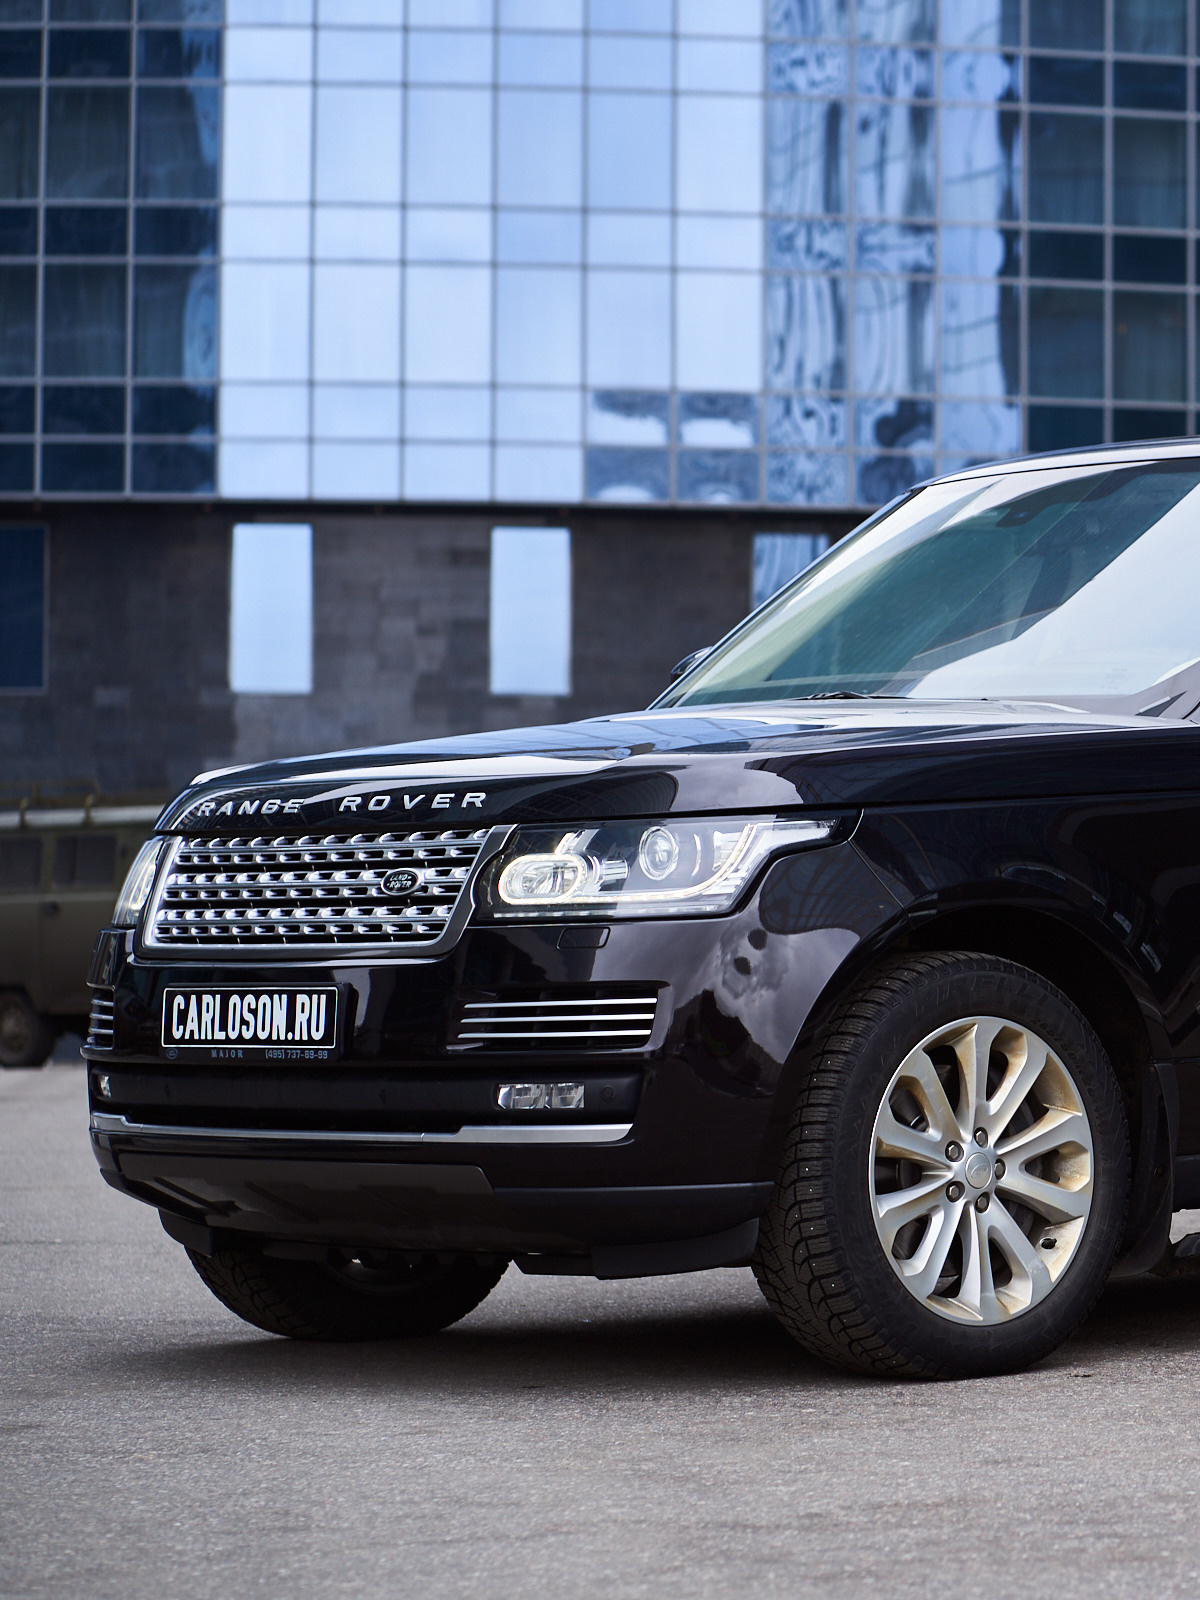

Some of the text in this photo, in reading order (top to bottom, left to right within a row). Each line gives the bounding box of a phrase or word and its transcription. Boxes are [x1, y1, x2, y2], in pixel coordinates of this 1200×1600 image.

[197, 792, 487, 817] RANGE ROVER
[389, 873, 408, 881] LAND
[389, 880, 412, 888] ROVER
[172, 993, 327, 1041] CARLOSON.RU
[211, 1049, 243, 1058] MAJOR
[286, 1050, 328, 1059] 737-89-99
